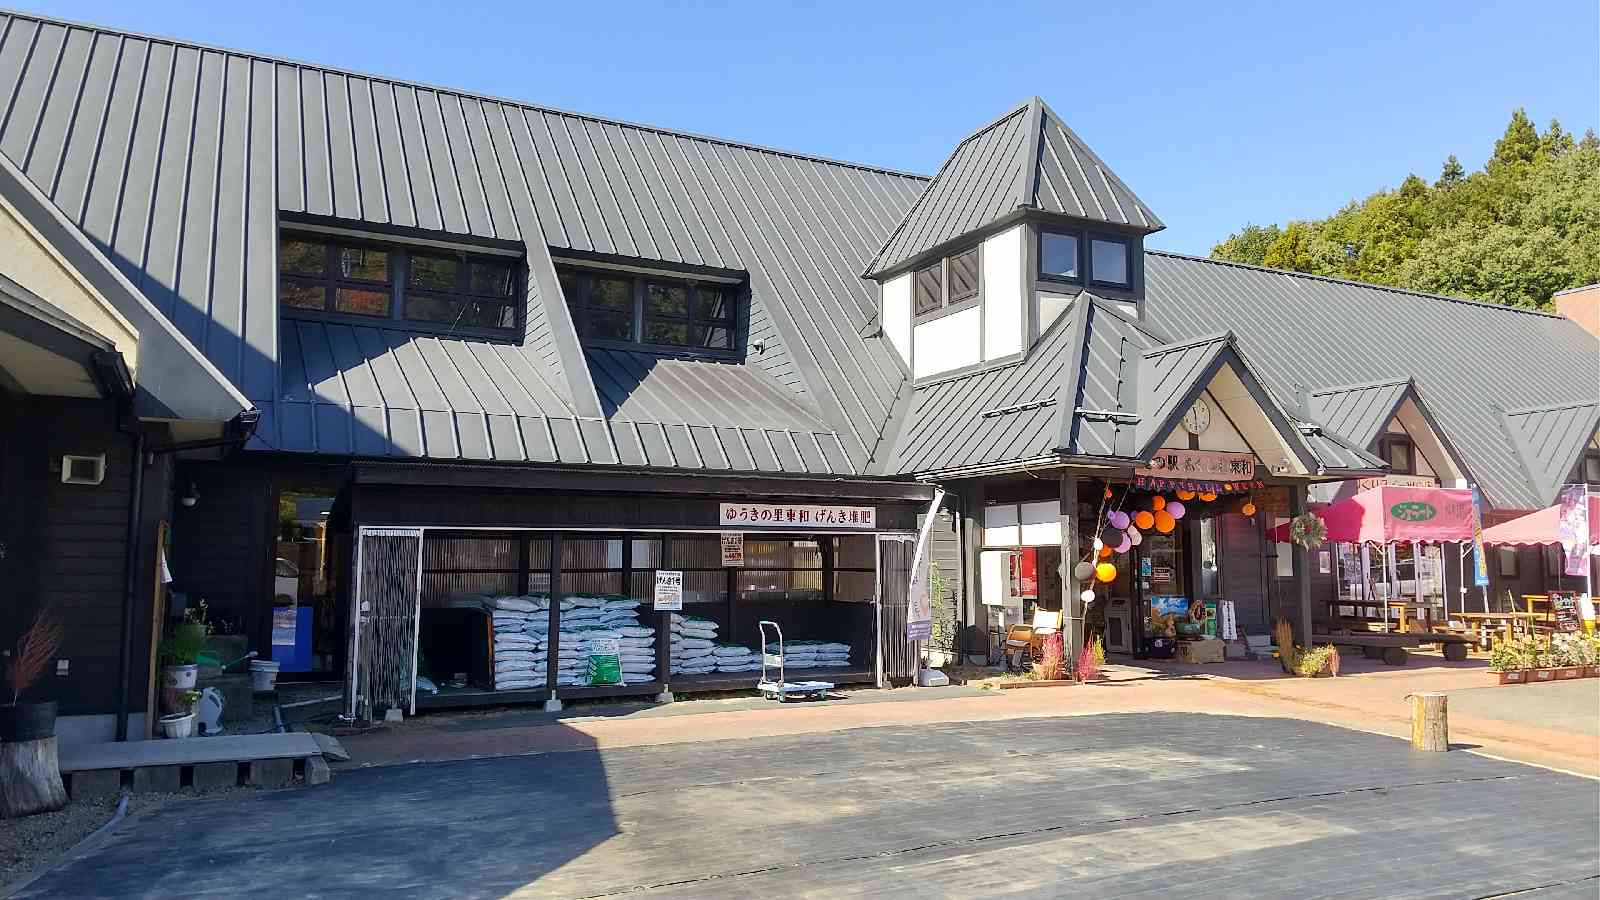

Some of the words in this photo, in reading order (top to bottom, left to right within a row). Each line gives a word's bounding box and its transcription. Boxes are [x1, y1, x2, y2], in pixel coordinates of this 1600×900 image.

[725, 507, 810, 523] ゆうきの里東和
[815, 508, 872, 524] げんき堆肥
